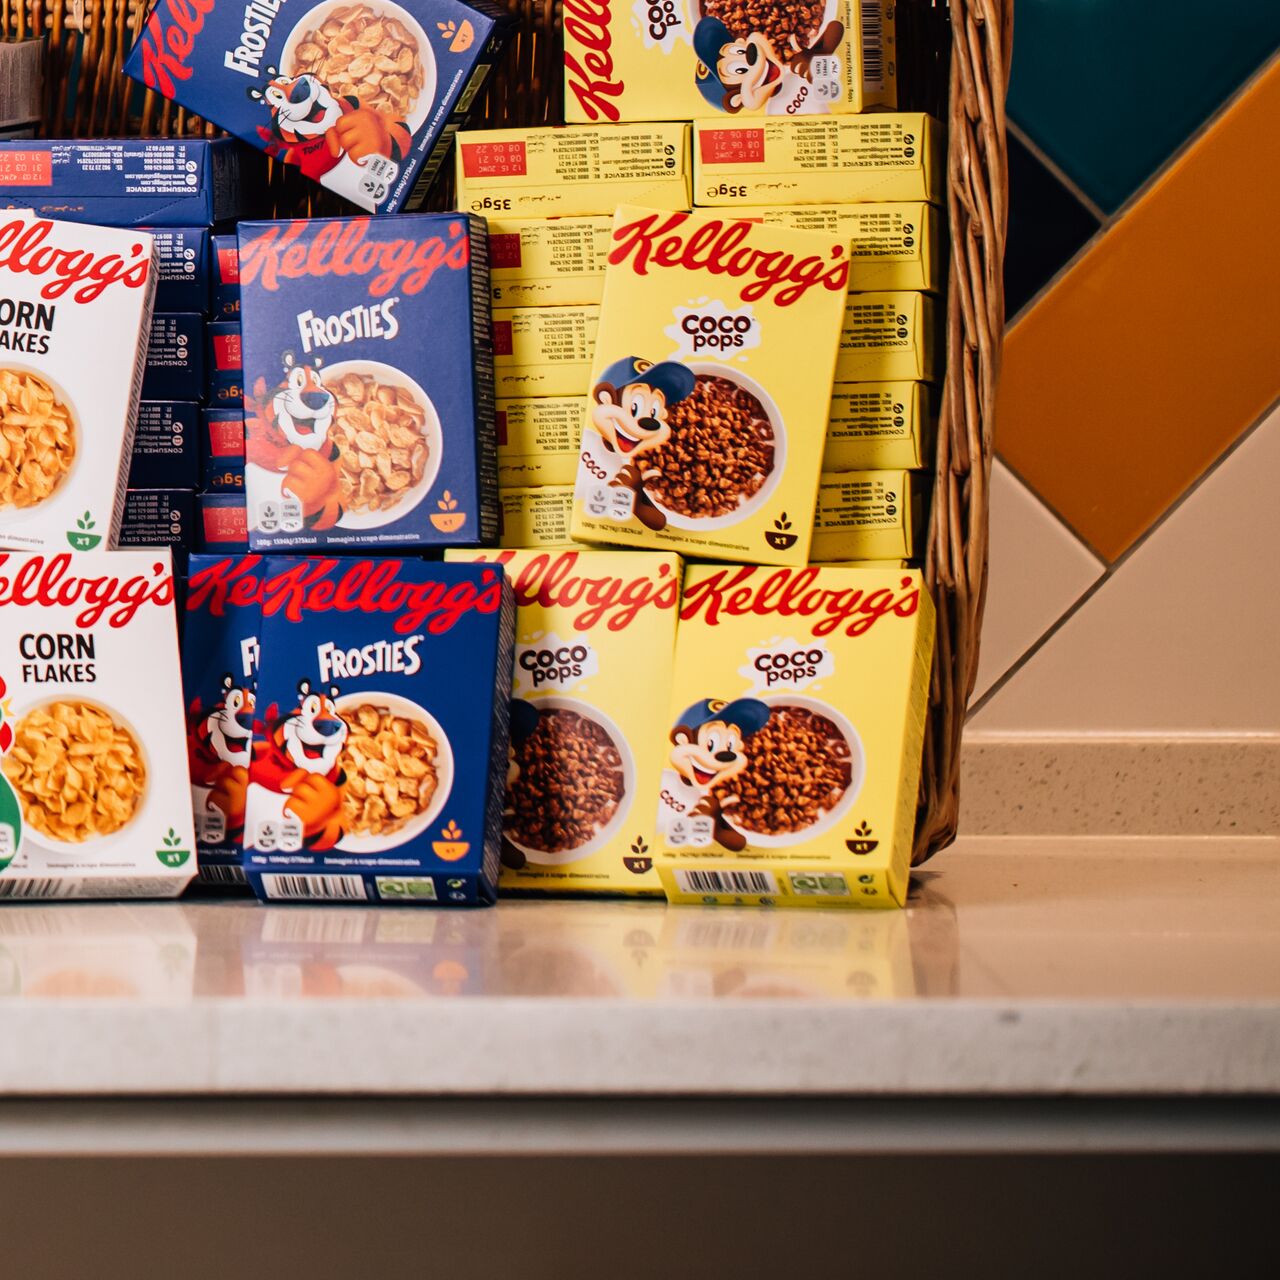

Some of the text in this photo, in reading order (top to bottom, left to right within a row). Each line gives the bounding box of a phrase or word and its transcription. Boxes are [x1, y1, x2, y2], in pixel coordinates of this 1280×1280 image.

[635, 170, 676, 178] CONSUMER
[239, 217, 471, 298] Kellogg's
[607, 212, 849, 306] Kellogg's
[296, 299, 399, 354] FROSTIES
[693, 332, 744, 352] pops
[262, 558, 502, 635] Kellogg's
[679, 566, 919, 637] Kellogg's
[19, 633, 96, 661] CORN
[316, 636, 421, 684] FROSTIES
[22, 663, 97, 684] FLAKES
[532, 663, 582, 687] pops
[766, 665, 817, 687] pops
